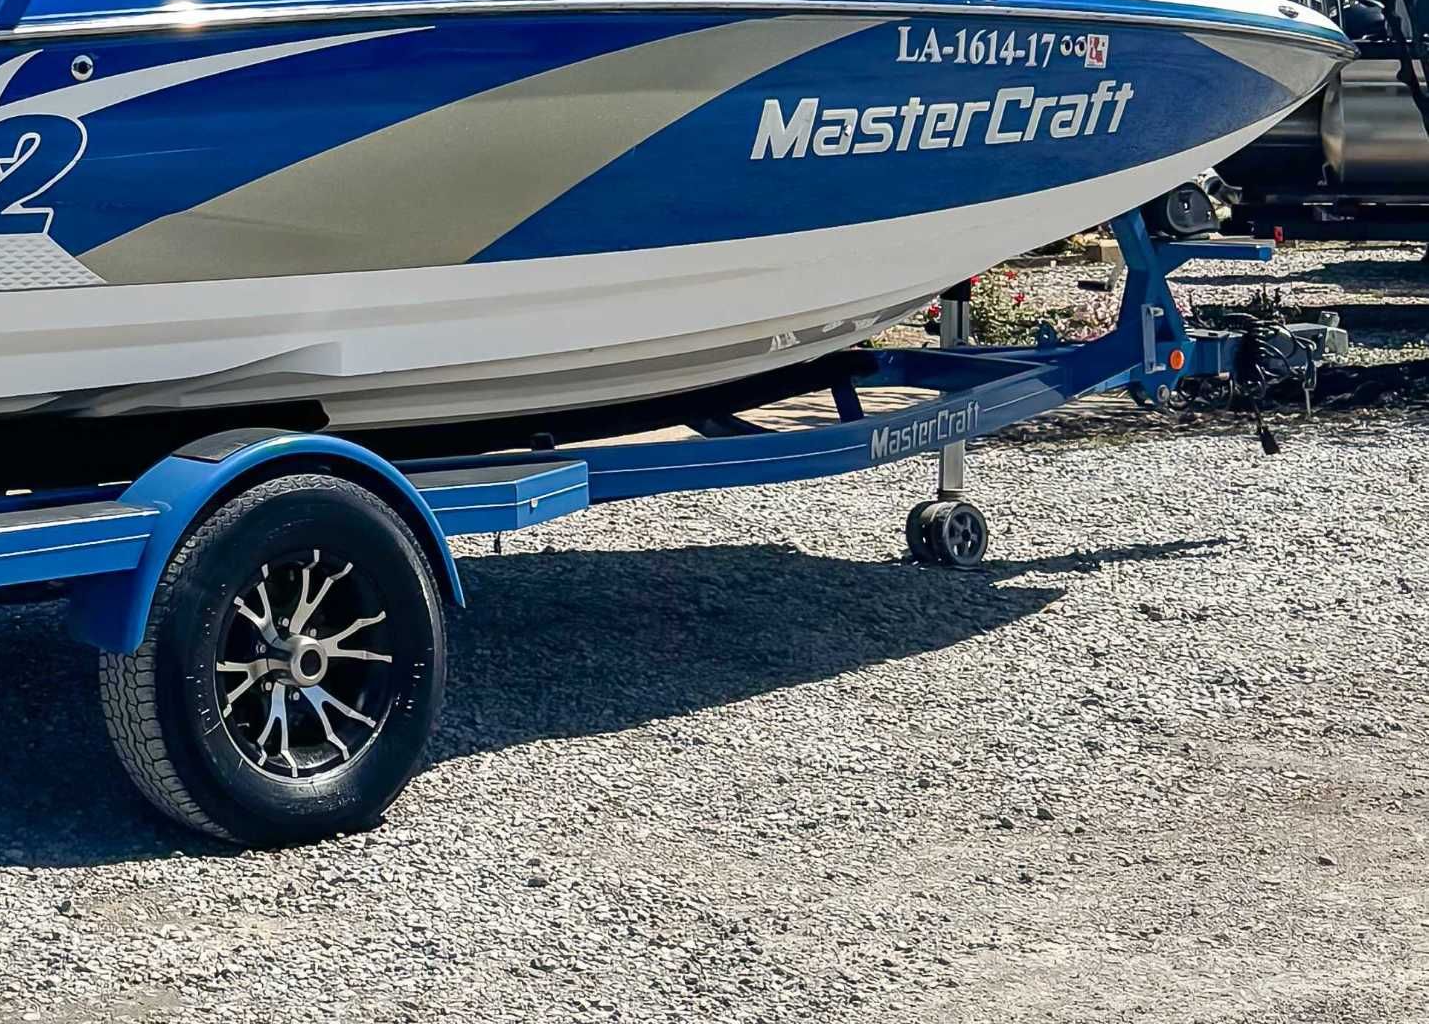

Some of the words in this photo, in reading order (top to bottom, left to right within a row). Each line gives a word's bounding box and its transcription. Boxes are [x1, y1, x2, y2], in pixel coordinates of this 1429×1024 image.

[896, 26, 1056, 68] LA-1614-17
[750, 79, 1135, 160] MasterCraft
[871, 400, 980, 460] MasterCraft
